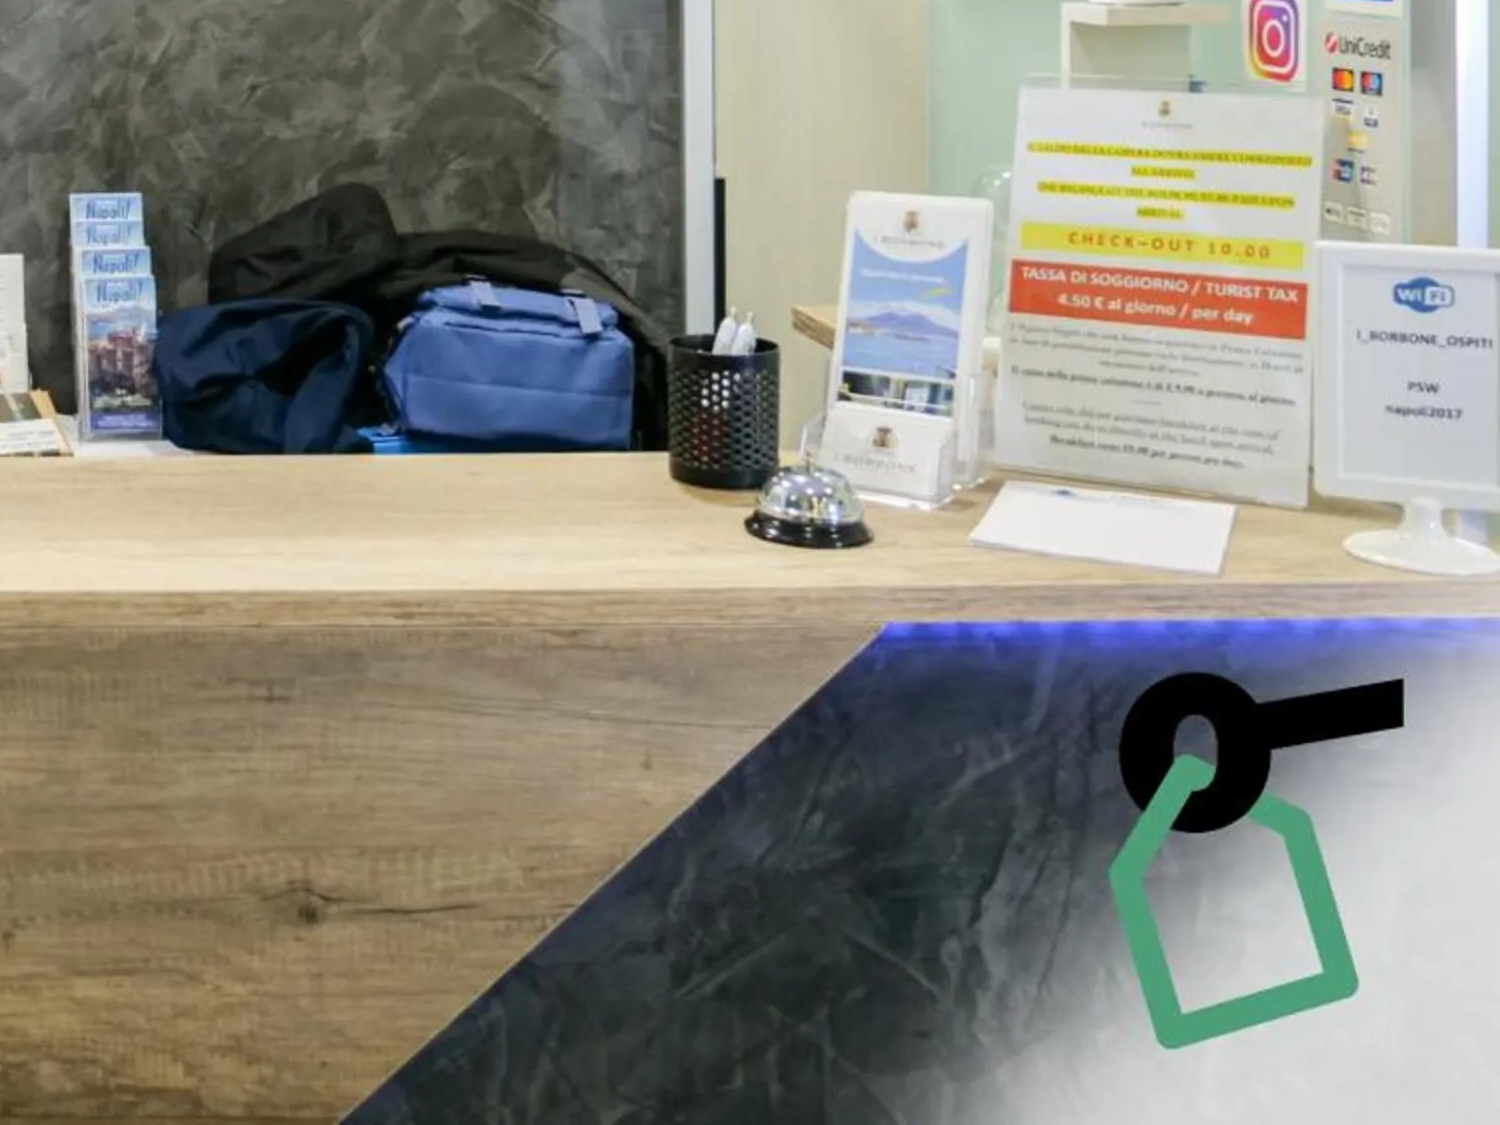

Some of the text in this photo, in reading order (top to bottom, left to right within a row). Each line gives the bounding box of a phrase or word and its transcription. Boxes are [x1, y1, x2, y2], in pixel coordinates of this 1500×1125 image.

[1338, 33, 1391, 59] UniCredit
[1068, 231, 1271, 259] CHECK-OUT 10.00
[1020, 265, 1067, 283] TASSA
[1070, 269, 1088, 285] DI
[1090, 272, 1188, 293] SOGGIORNO
[1206, 282, 1263, 300] TURIST
[1267, 287, 1299, 303] TAX
[1057, 293, 1091, 309] 4.50
[1094, 296, 1104, 310] €
[1107, 295, 1121, 311] al
[1124, 298, 1177, 318] giorno
[1192, 306, 1220, 322] per
[1223, 303, 1254, 326] day
[1356, 329, 1493, 350] I_BORBONE_OSPITI
[1407, 380, 1440, 394] PSW
